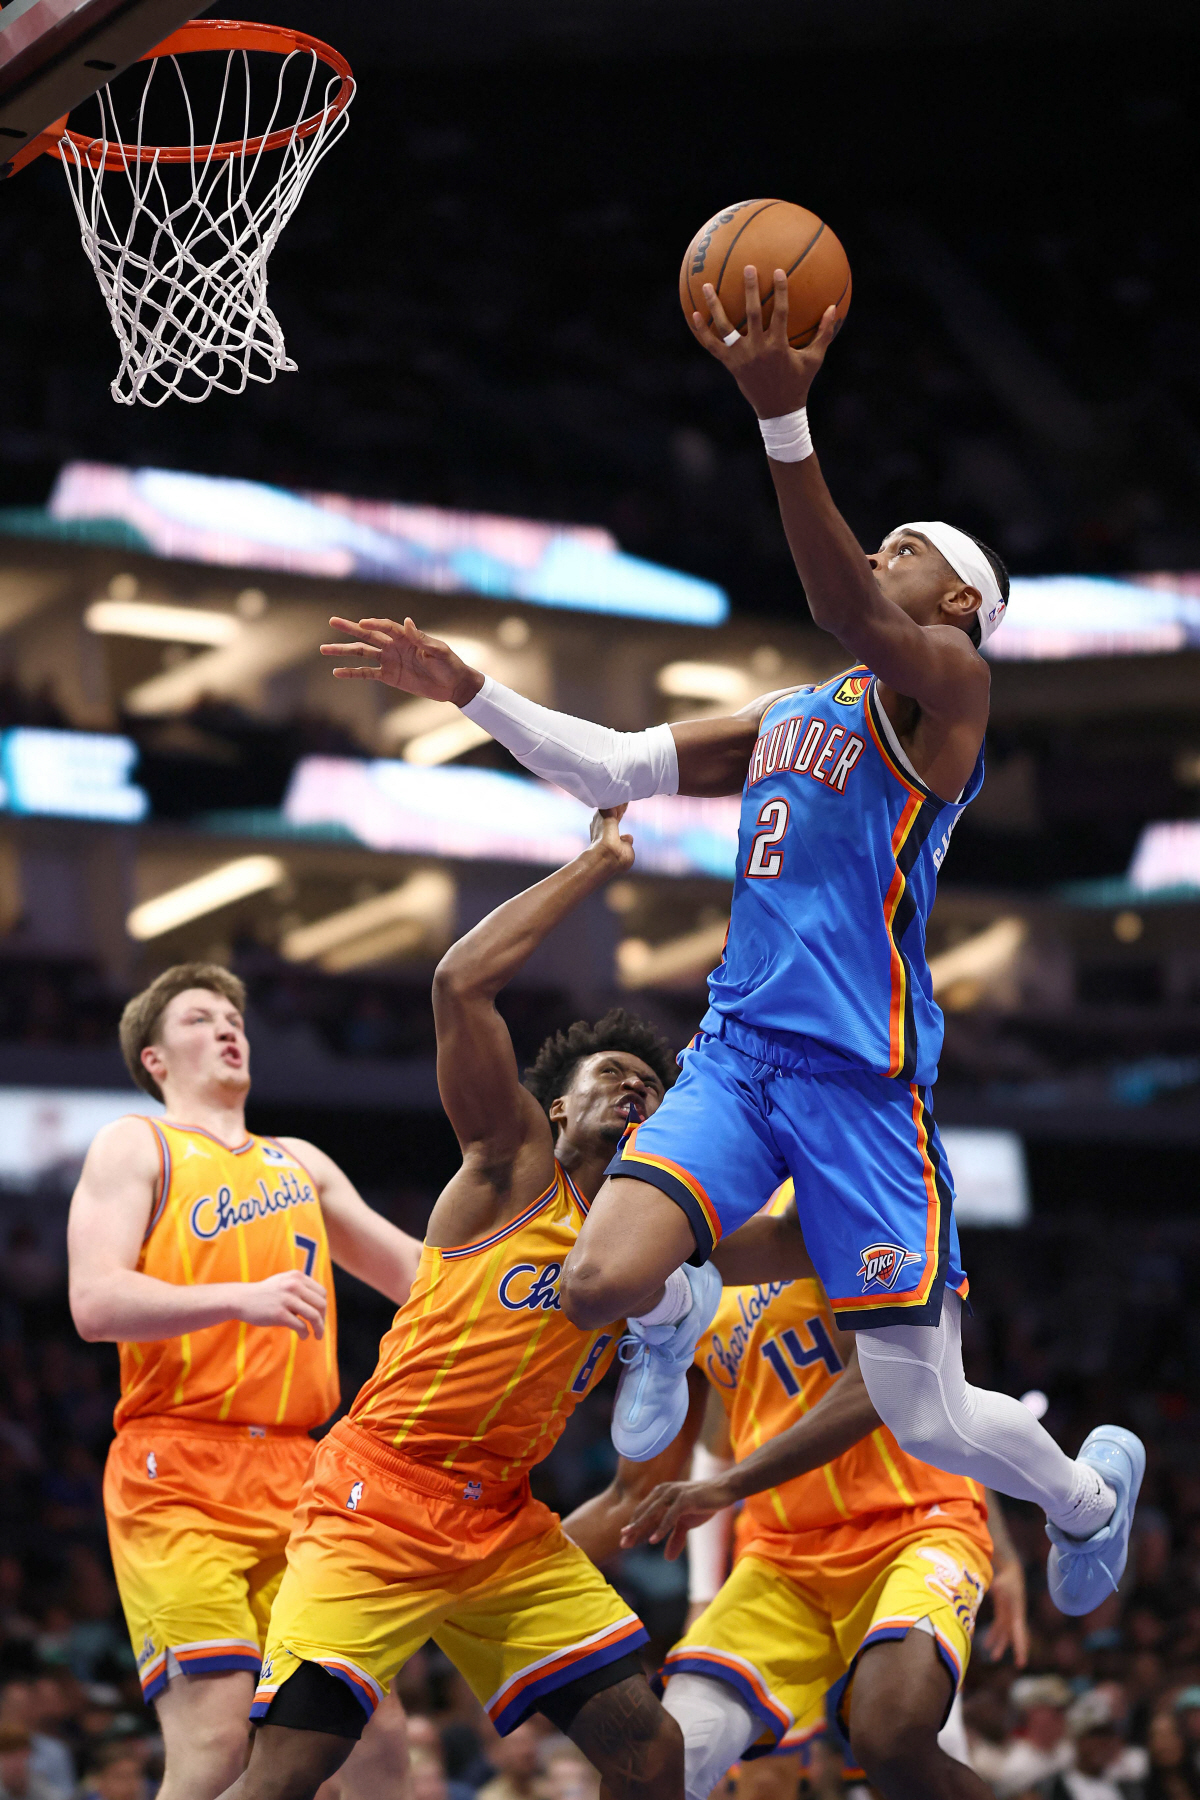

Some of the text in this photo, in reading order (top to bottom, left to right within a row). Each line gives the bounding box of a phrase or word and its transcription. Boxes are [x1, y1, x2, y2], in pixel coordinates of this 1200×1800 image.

[746, 715, 866, 796] HUNDER
[744, 797, 790, 879] 2
[190, 1171, 315, 1240] Charlotte
[294, 1233, 317, 1277] 7
[866, 1252, 894, 1281] OKC
[571, 1333, 613, 1393] 8
[707, 1280, 795, 1389] Charlot
[760, 1315, 845, 1398] 14
